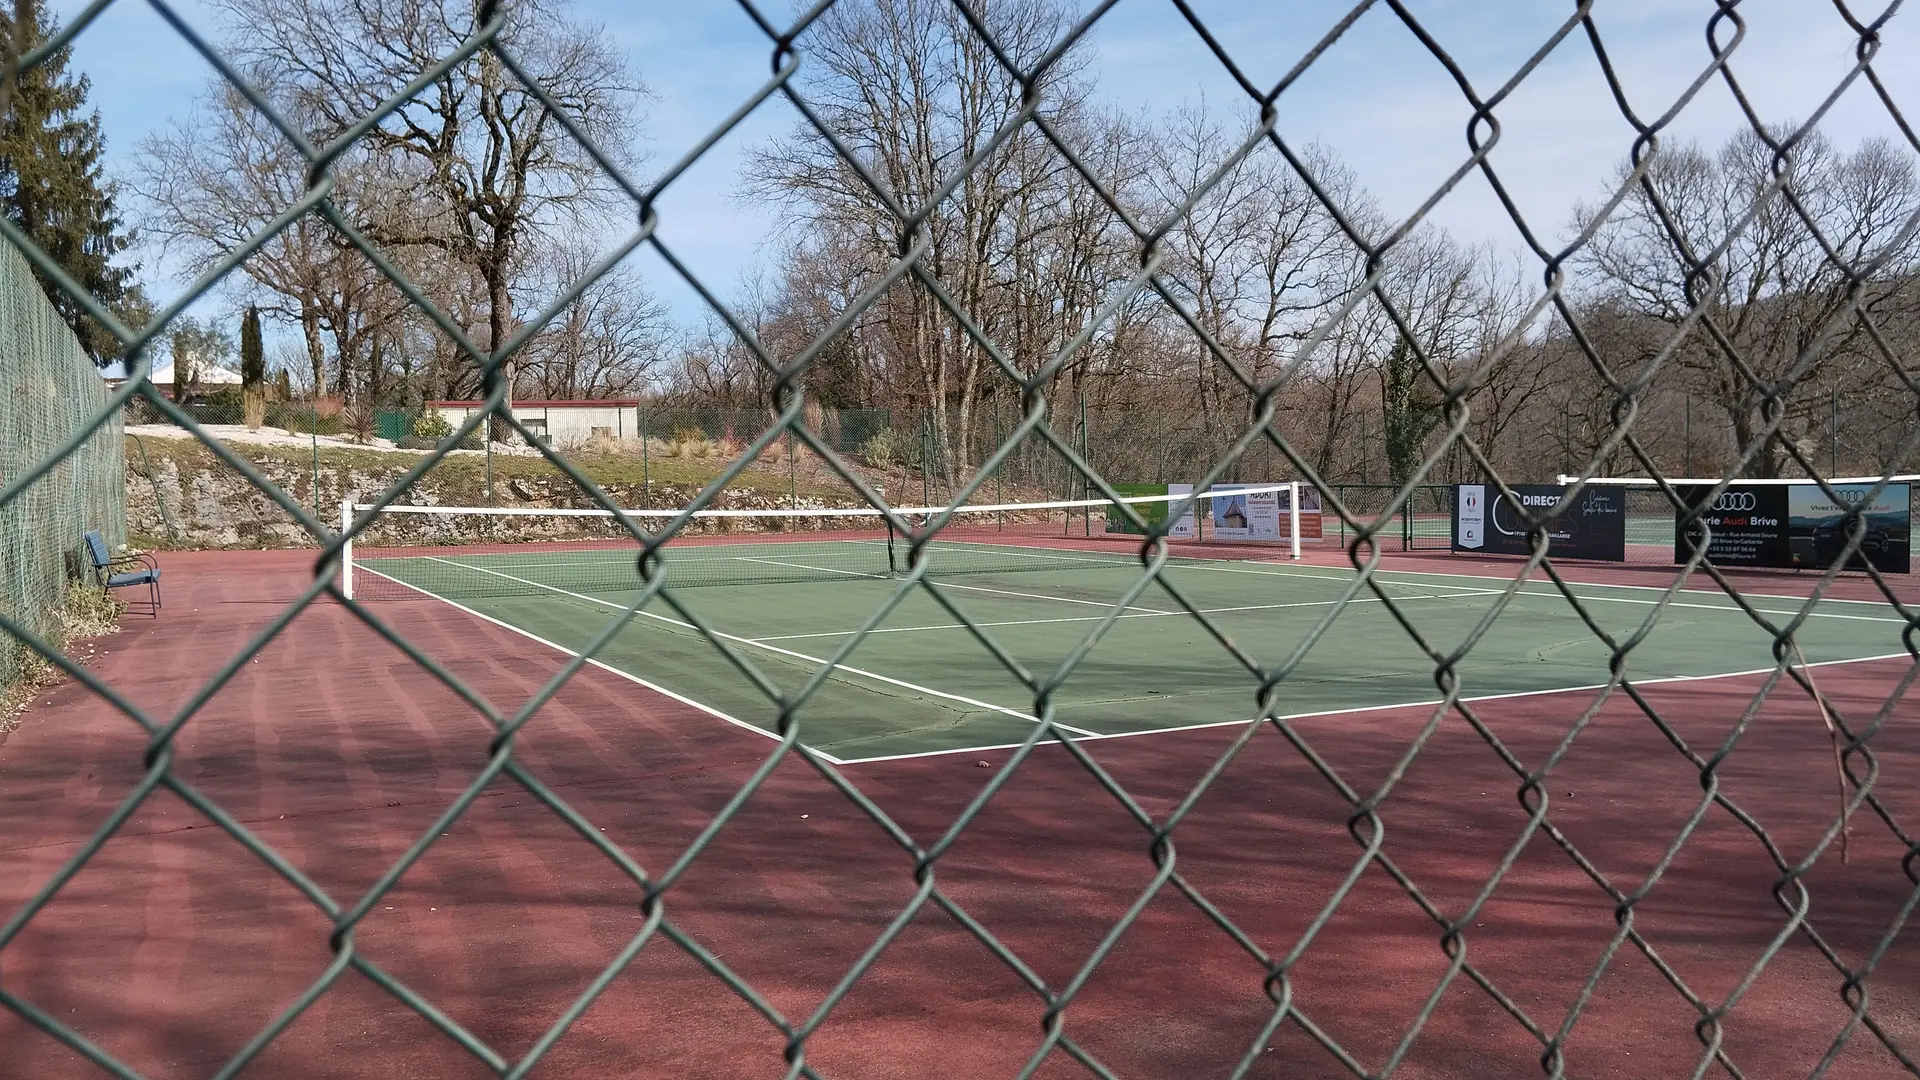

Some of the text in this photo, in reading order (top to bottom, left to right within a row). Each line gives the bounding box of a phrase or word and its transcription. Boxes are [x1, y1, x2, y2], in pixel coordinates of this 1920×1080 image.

[1522, 495, 1562, 506] DIRECT
[1722, 516, 1748, 525] Audi
[1750, 516, 1778, 526] Brive
